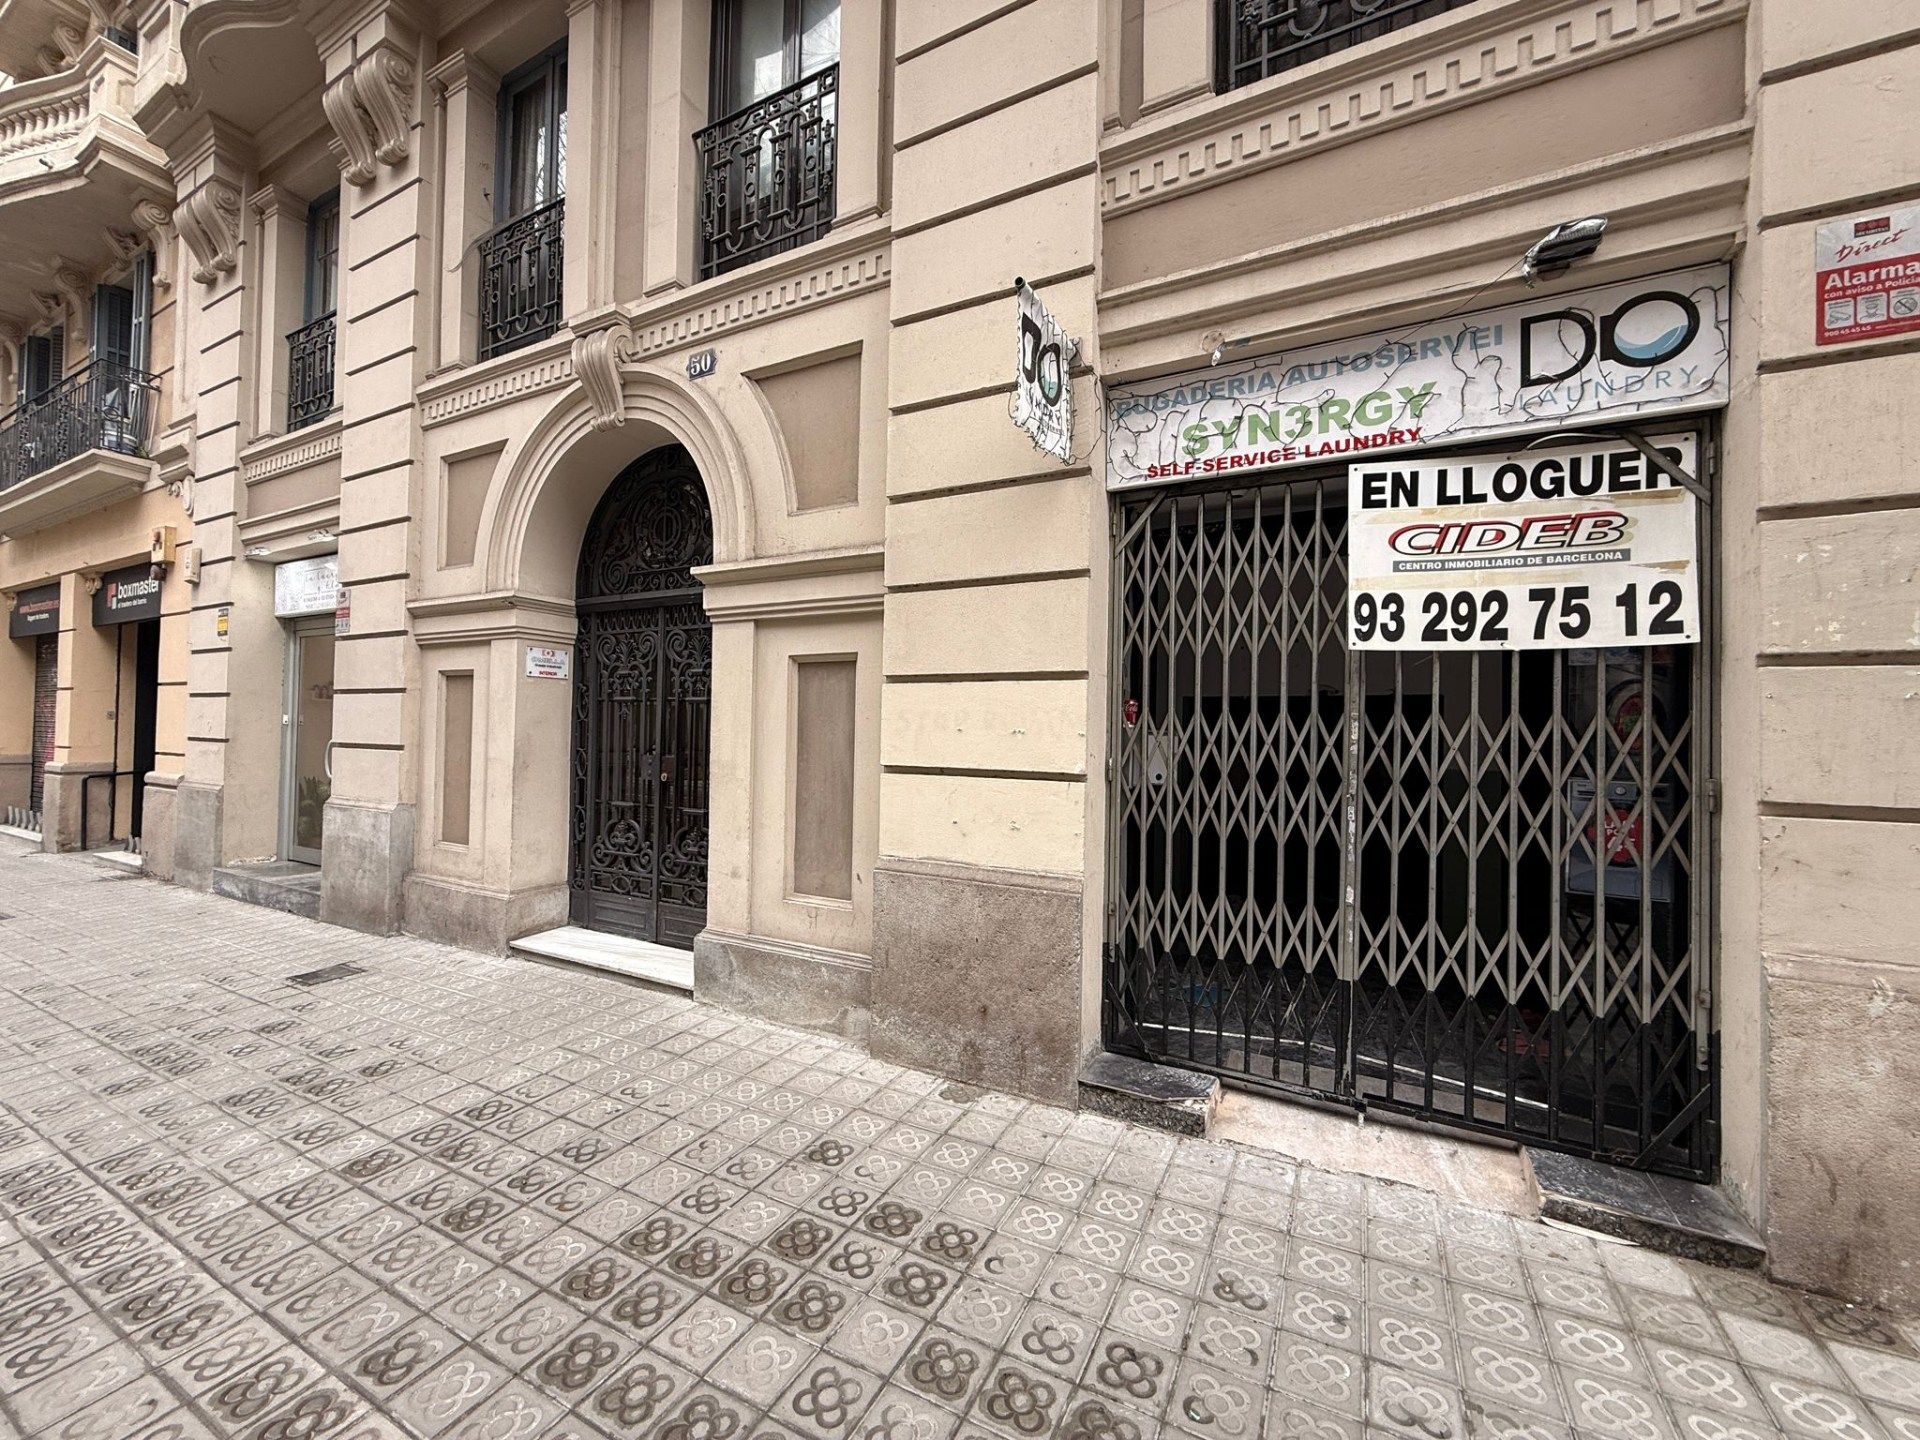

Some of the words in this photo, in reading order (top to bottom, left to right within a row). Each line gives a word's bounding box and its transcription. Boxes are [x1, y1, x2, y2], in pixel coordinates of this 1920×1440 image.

[1834, 228, 1911, 263] Direct
[1824, 261, 1920, 290] Alarma
[1824, 290, 1843, 299] con
[1845, 284, 1873, 296] aviso
[690, 352, 711, 375] 50
[1115, 371, 1277, 418] BUGADERIA
[1286, 324, 1503, 386] AUTOSERVEI
[1519, 365, 1698, 410] LAUNDRY
[1181, 382, 1437, 456] SYN3RGY
[1147, 446, 1297, 478] SELF-SERVICE
[1304, 427, 1424, 458] LAUNDRY
[1362, 470, 1420, 509] EN
[1436, 447, 1684, 505] LLOGUER
[1388, 511, 1629, 556] CIDEB
[1398, 560, 1444, 571] CENTRO
[1444, 557, 1524, 570] INMOBILIARIO
[1527, 556, 1544, 566] DE
[1546, 551, 1623, 565] BARCELONA
[118, 576, 159, 599] boxmaster
[1353, 592, 1405, 643] 93
[1421, 589, 1509, 642] 292
[1528, 586, 1591, 640] 75
[1616, 580, 1685, 636] 12
